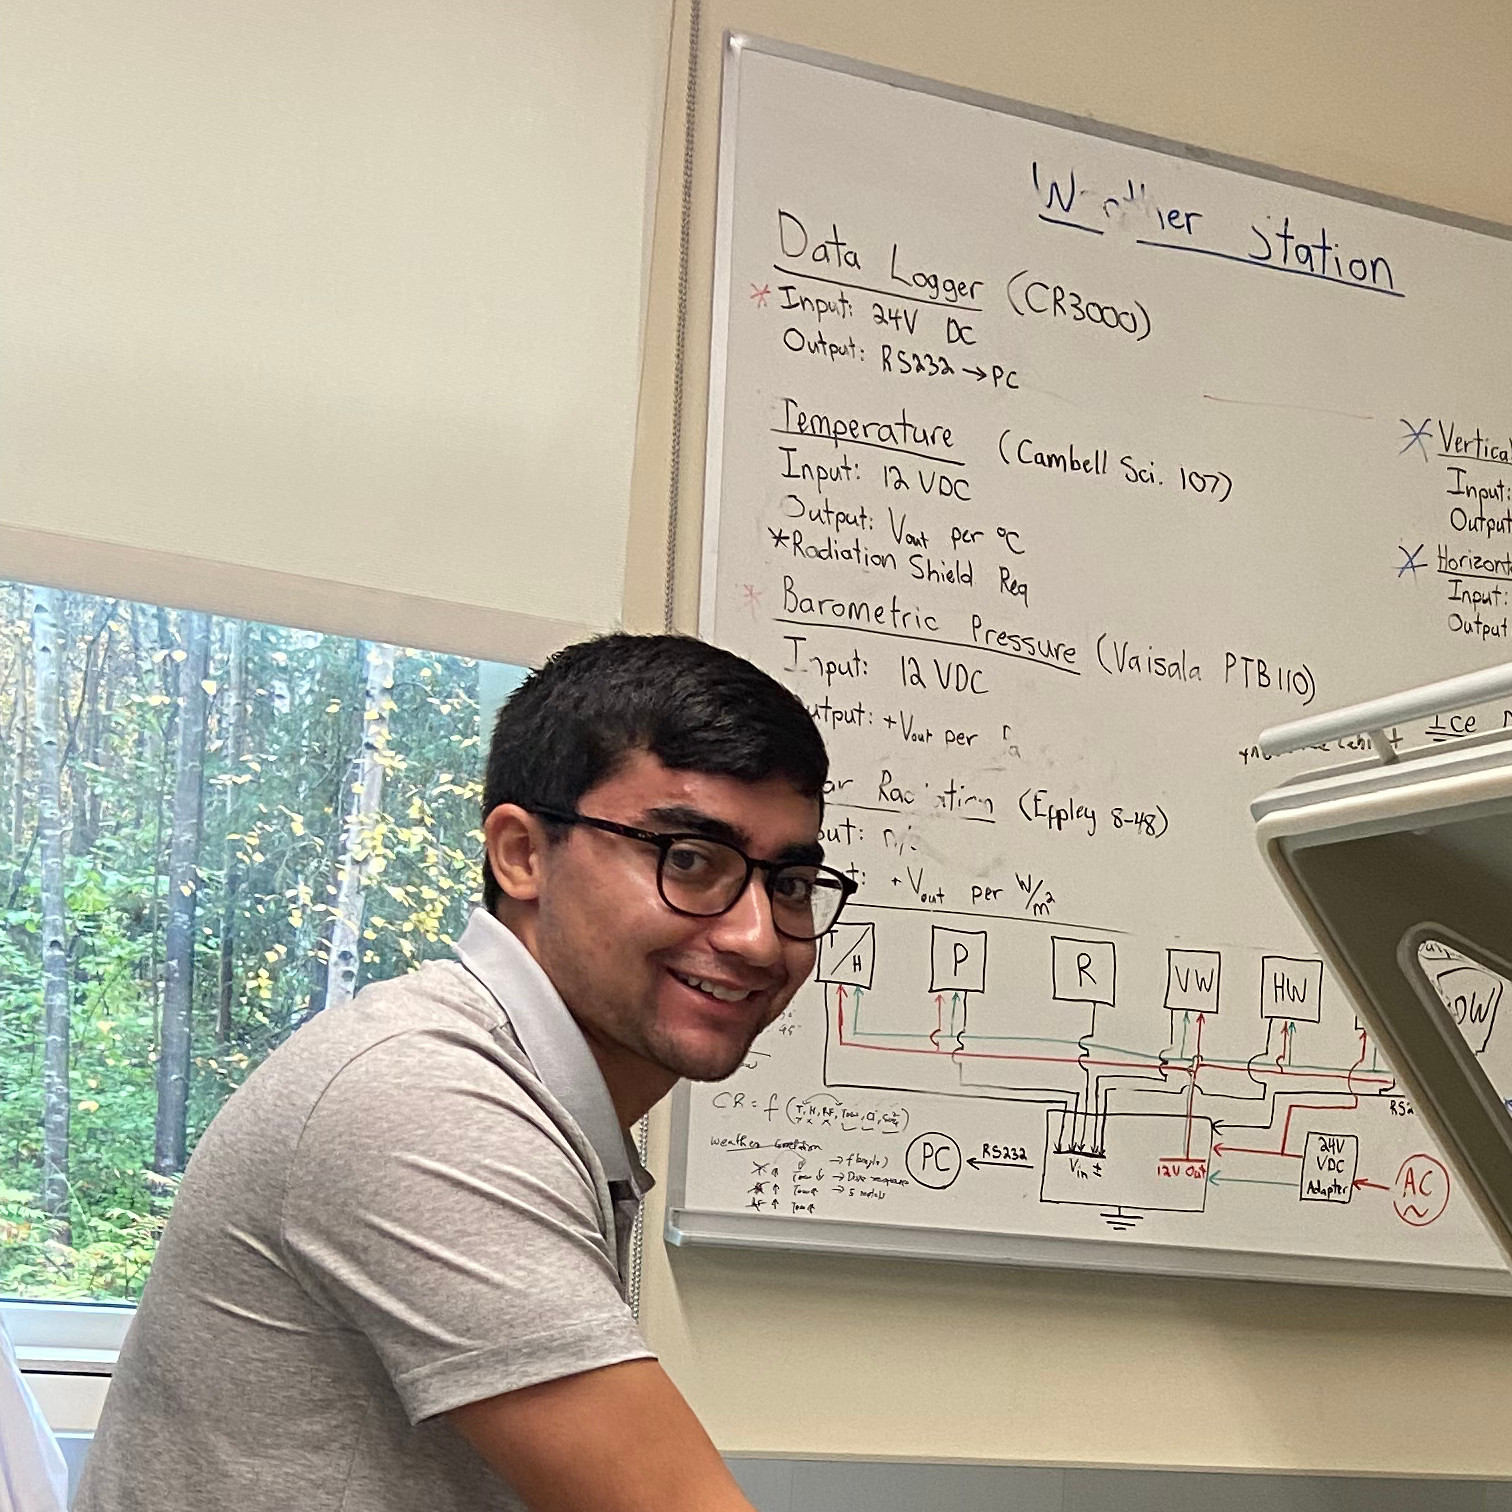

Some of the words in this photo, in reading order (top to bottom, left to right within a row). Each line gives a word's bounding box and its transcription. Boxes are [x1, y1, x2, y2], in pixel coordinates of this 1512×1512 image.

[778, 208, 861, 269] Data
[891, 243, 984, 301] Logger
[1007, 269, 1152, 342] (CR3000)
[779, 284, 854, 321] Input:
[872, 302, 919, 334] 24V
[946, 318, 977, 345] DC
[782, 328, 866, 361] Output:
[882, 344, 955, 375] RS232
[992, 365, 1019, 390] PC
[777, 397, 954, 448] Temperature
[999, 429, 1108, 475] (Cambell
[1120, 455, 1163, 485] Sci.
[1180, 467, 1233, 502] 107)
[778, 446, 860, 493] Input:
[883, 465, 910, 490] 12
[918, 470, 971, 501] VDC
[1446, 466, 1511, 498] Input:
[780, 494, 873, 532] Output:
[951, 526, 984, 550] per
[909, 553, 973, 587] Shield
[998, 565, 1029, 608] Req
[1448, 579, 1508, 606] Input:
[783, 575, 939, 631] Barometric
[971, 614, 1076, 663] Pressure
[1096, 632, 1201, 682] (Vaisala
[1224, 652, 1316, 706] PTB110)
[783, 635, 868, 686] Input:
[900, 656, 926, 688] 12
[934, 659, 988, 694] VDC
[805, 696, 873, 729] utput:
[944, 729, 978, 746] per
[972, 885, 1003, 903] per
[852, 955, 862, 972] H
[954, 942, 968, 977] P
[1077, 952, 1097, 988] R
[1175, 965, 1214, 993] VW
[1274, 972, 1307, 1003] HW
[922, 1142, 950, 1172] PC
[982, 1143, 1028, 1162] RS232
[1318, 1136, 1345, 1155] 24V
[1317, 1155, 1344, 1173] VDC
[1307, 1178, 1348, 1200] Adapter
[1403, 1166, 1433, 1197] AC
